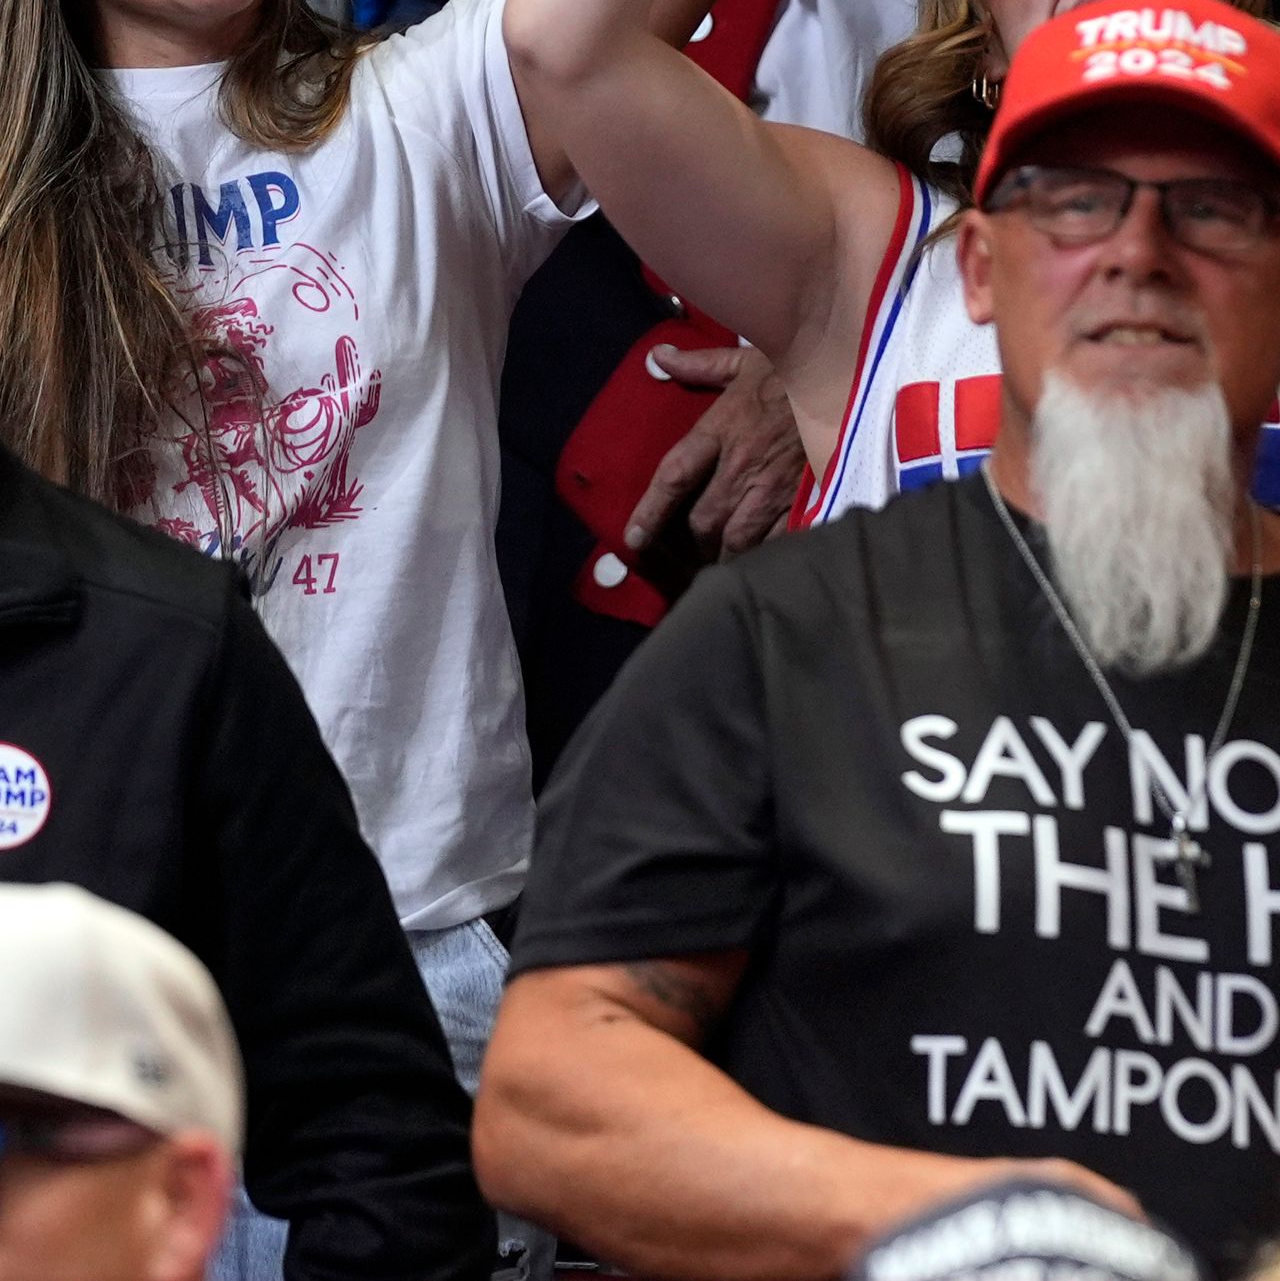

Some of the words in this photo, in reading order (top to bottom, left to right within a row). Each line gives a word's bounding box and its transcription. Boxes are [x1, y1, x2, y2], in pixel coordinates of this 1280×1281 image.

[1075, 7, 1247, 56] TRUMP
[1082, 47, 1232, 91] 2024
[292, 552, 339, 596] 47
[900, 714, 1108, 810] SAY
[940, 810, 1210, 961] THE
[1085, 960, 1280, 1056] AND
